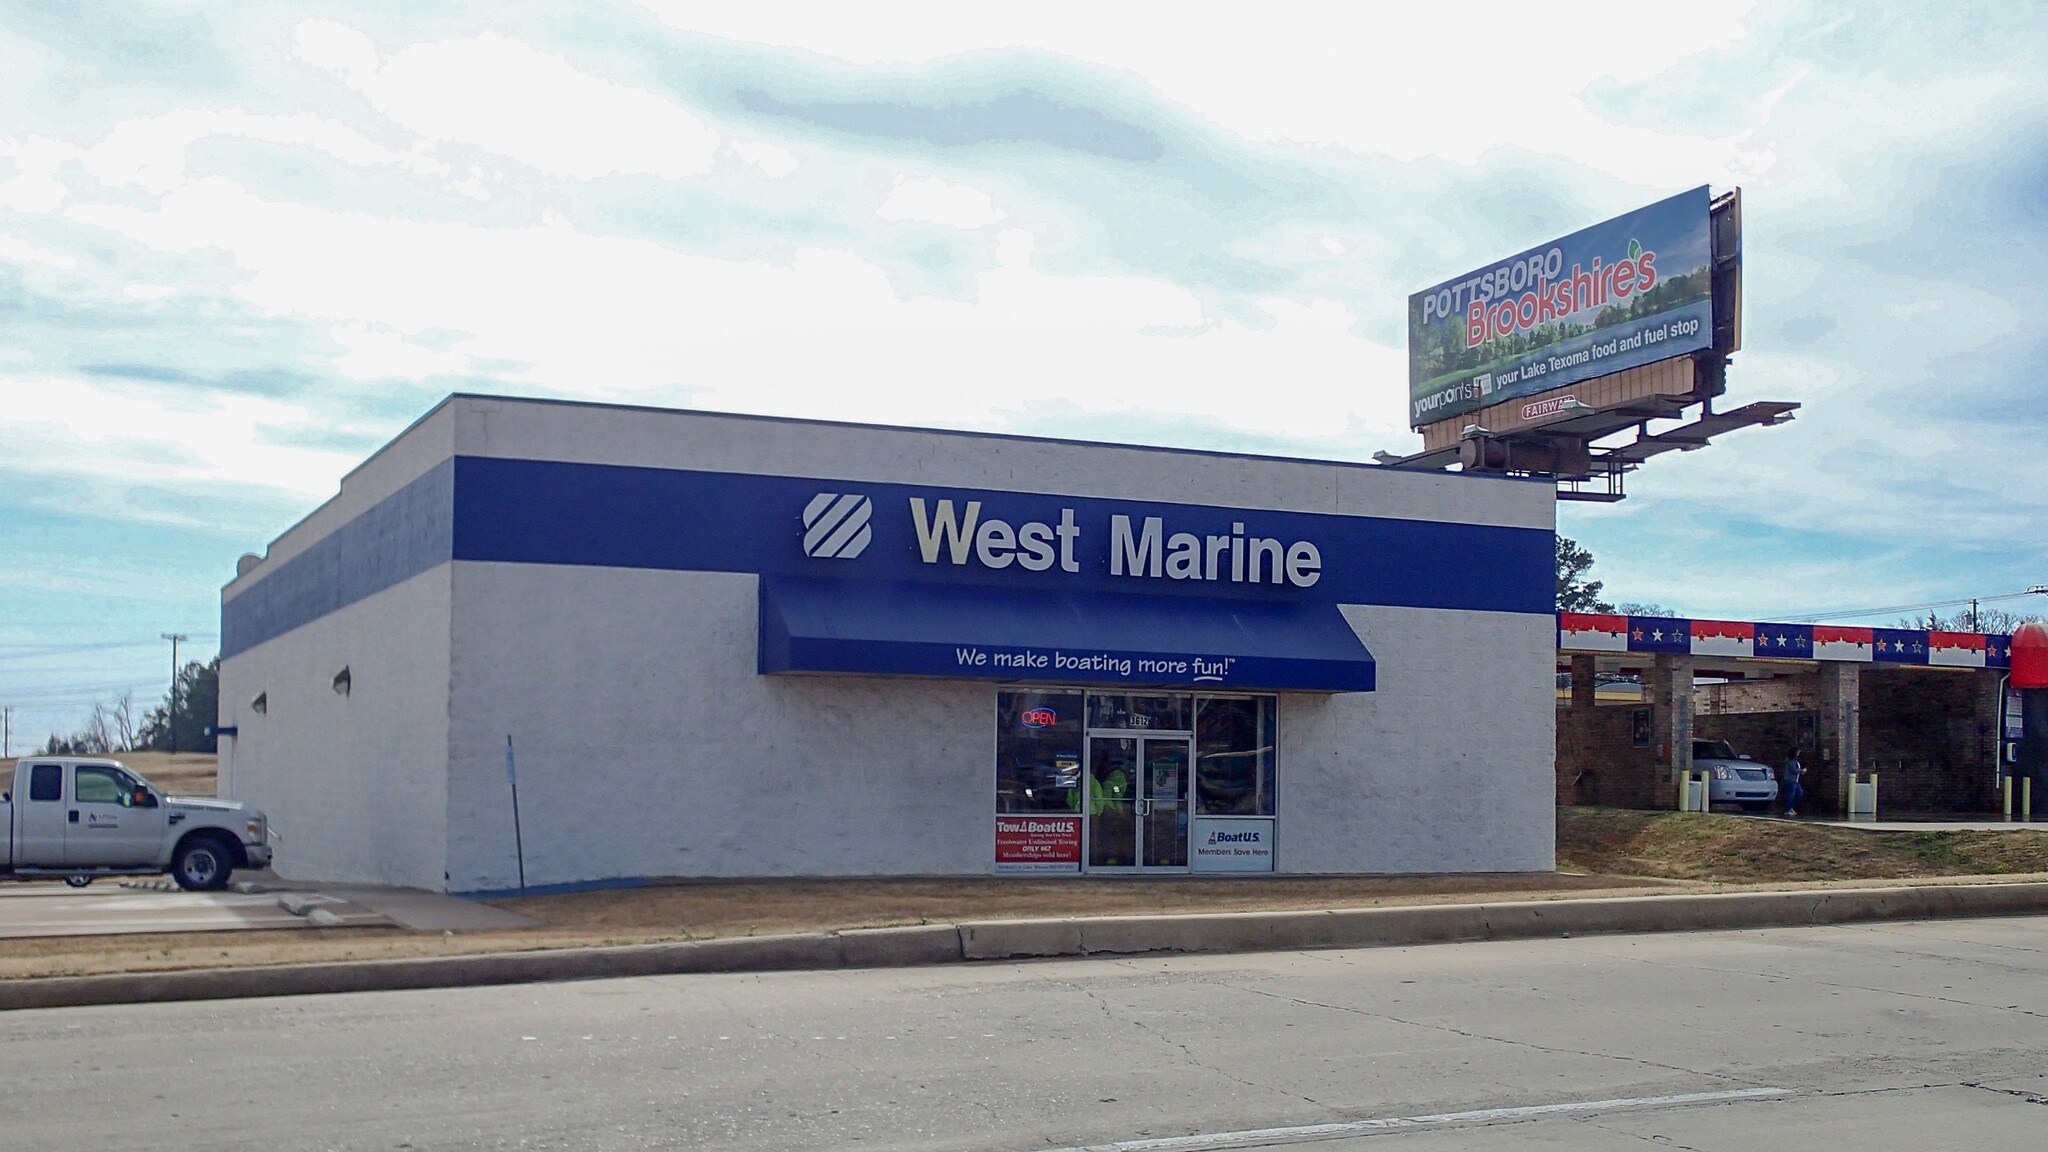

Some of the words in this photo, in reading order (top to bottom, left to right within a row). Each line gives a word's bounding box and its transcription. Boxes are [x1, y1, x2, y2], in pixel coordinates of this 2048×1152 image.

[1423, 248, 1563, 325] POTTSBORO
[1467, 242, 1657, 348] Brookshire's
[1496, 371, 1519, 390] your
[1521, 362, 1547, 380] Lake
[1548, 350, 1590, 372] Texoma
[1592, 340, 1617, 360] food
[1620, 332, 1642, 352] and
[1644, 325, 1667, 345] fuel
[1670, 319, 1699, 336] stop
[1525, 398, 1571, 417] FAIRWA
[909, 497, 1081, 573] West
[1110, 515, 1323, 588] Marine
[956, 648, 987, 666] We
[994, 650, 1049, 668] make
[1055, 651, 1132, 676] boating
[1138, 658, 1188, 674] more
[1021, 710, 1056, 726] OPEN
[1130, 715, 1149, 726] 3612
[1198, 847, 1232, 856] Members
[1233, 847, 1251, 856] Save
[1252, 847, 1269, 856] Here
